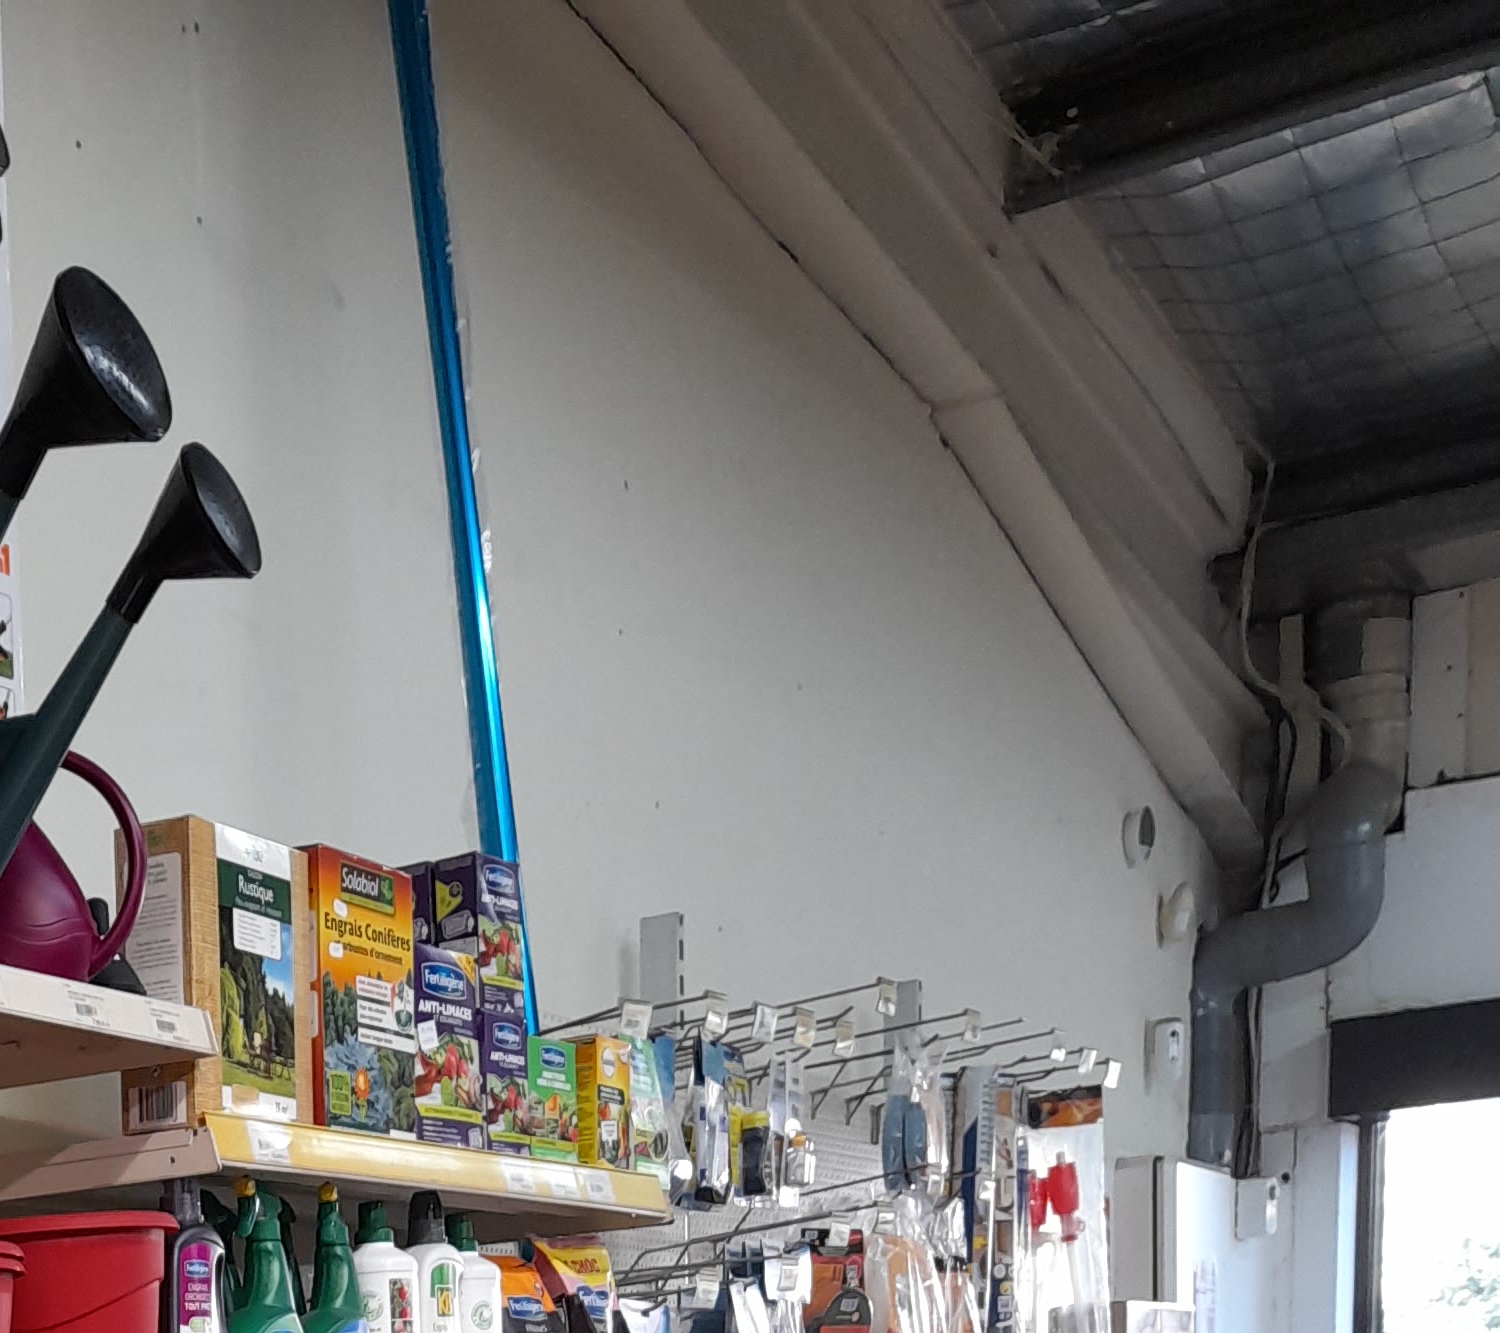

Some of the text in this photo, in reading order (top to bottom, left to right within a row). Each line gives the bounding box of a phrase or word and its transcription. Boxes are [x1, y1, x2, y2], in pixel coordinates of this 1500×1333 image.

[238, 874, 274, 903] Rustique
[341, 867, 378, 897] Solabiol
[324, 912, 411, 952] Engrais Conifères
[418, 999, 472, 1021] ANTI-LIMACES
